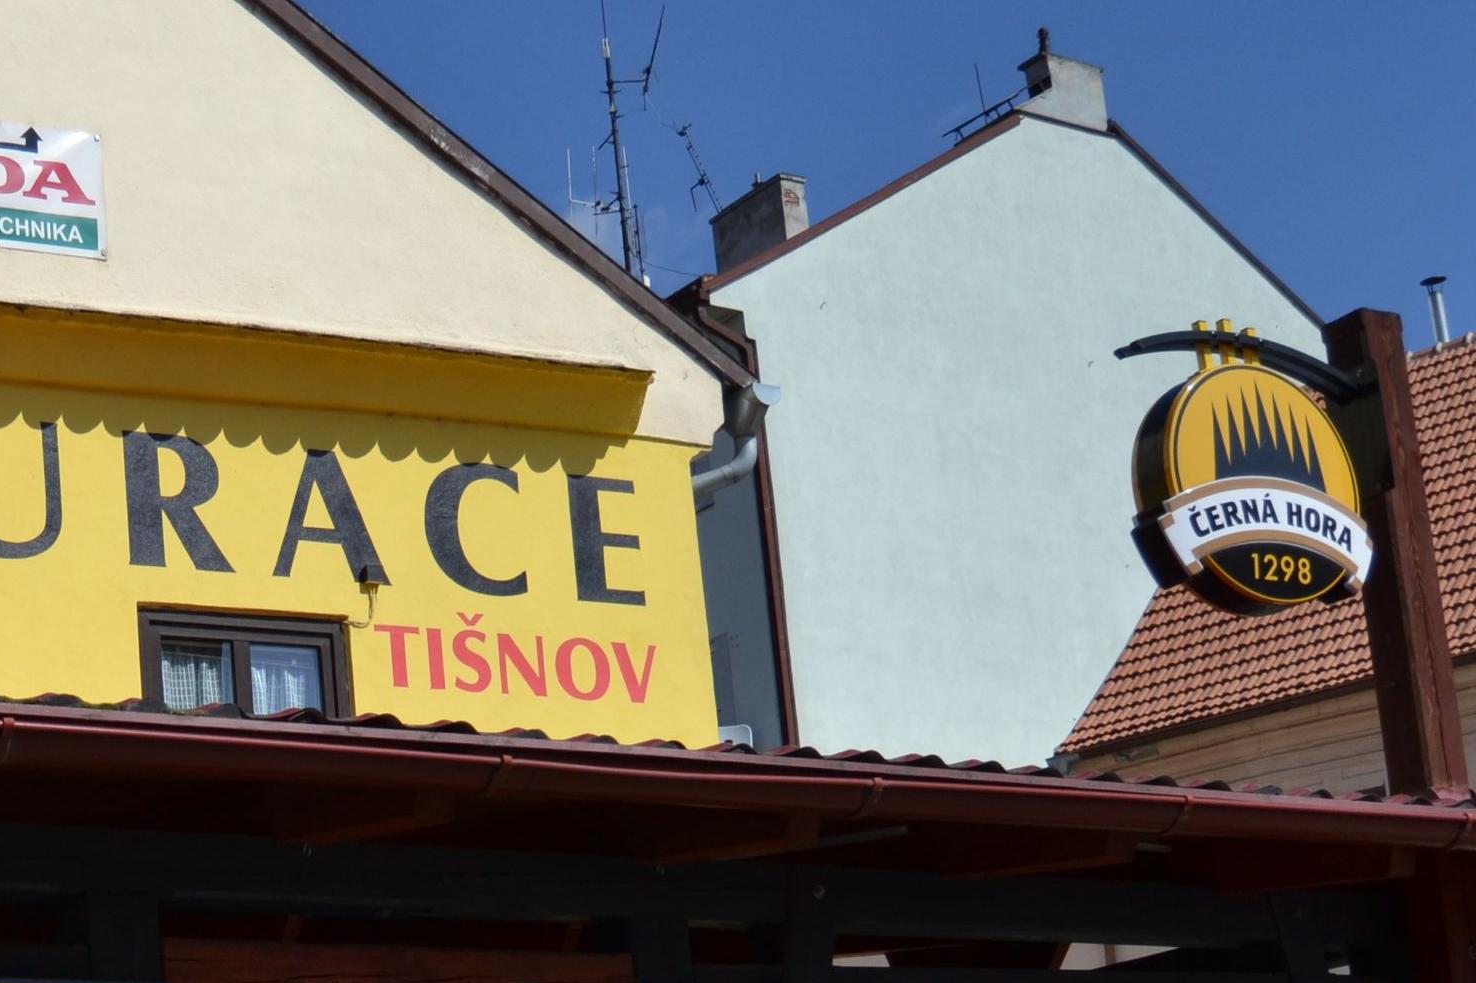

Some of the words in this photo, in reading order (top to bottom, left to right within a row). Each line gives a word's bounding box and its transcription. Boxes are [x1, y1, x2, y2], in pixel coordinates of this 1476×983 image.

[1187, 493, 1280, 538] ČERNÁ
[1286, 502, 1353, 554] HORA
[1251, 553, 1312, 585] 1298
[374, 612, 657, 703] TIŠNOV
